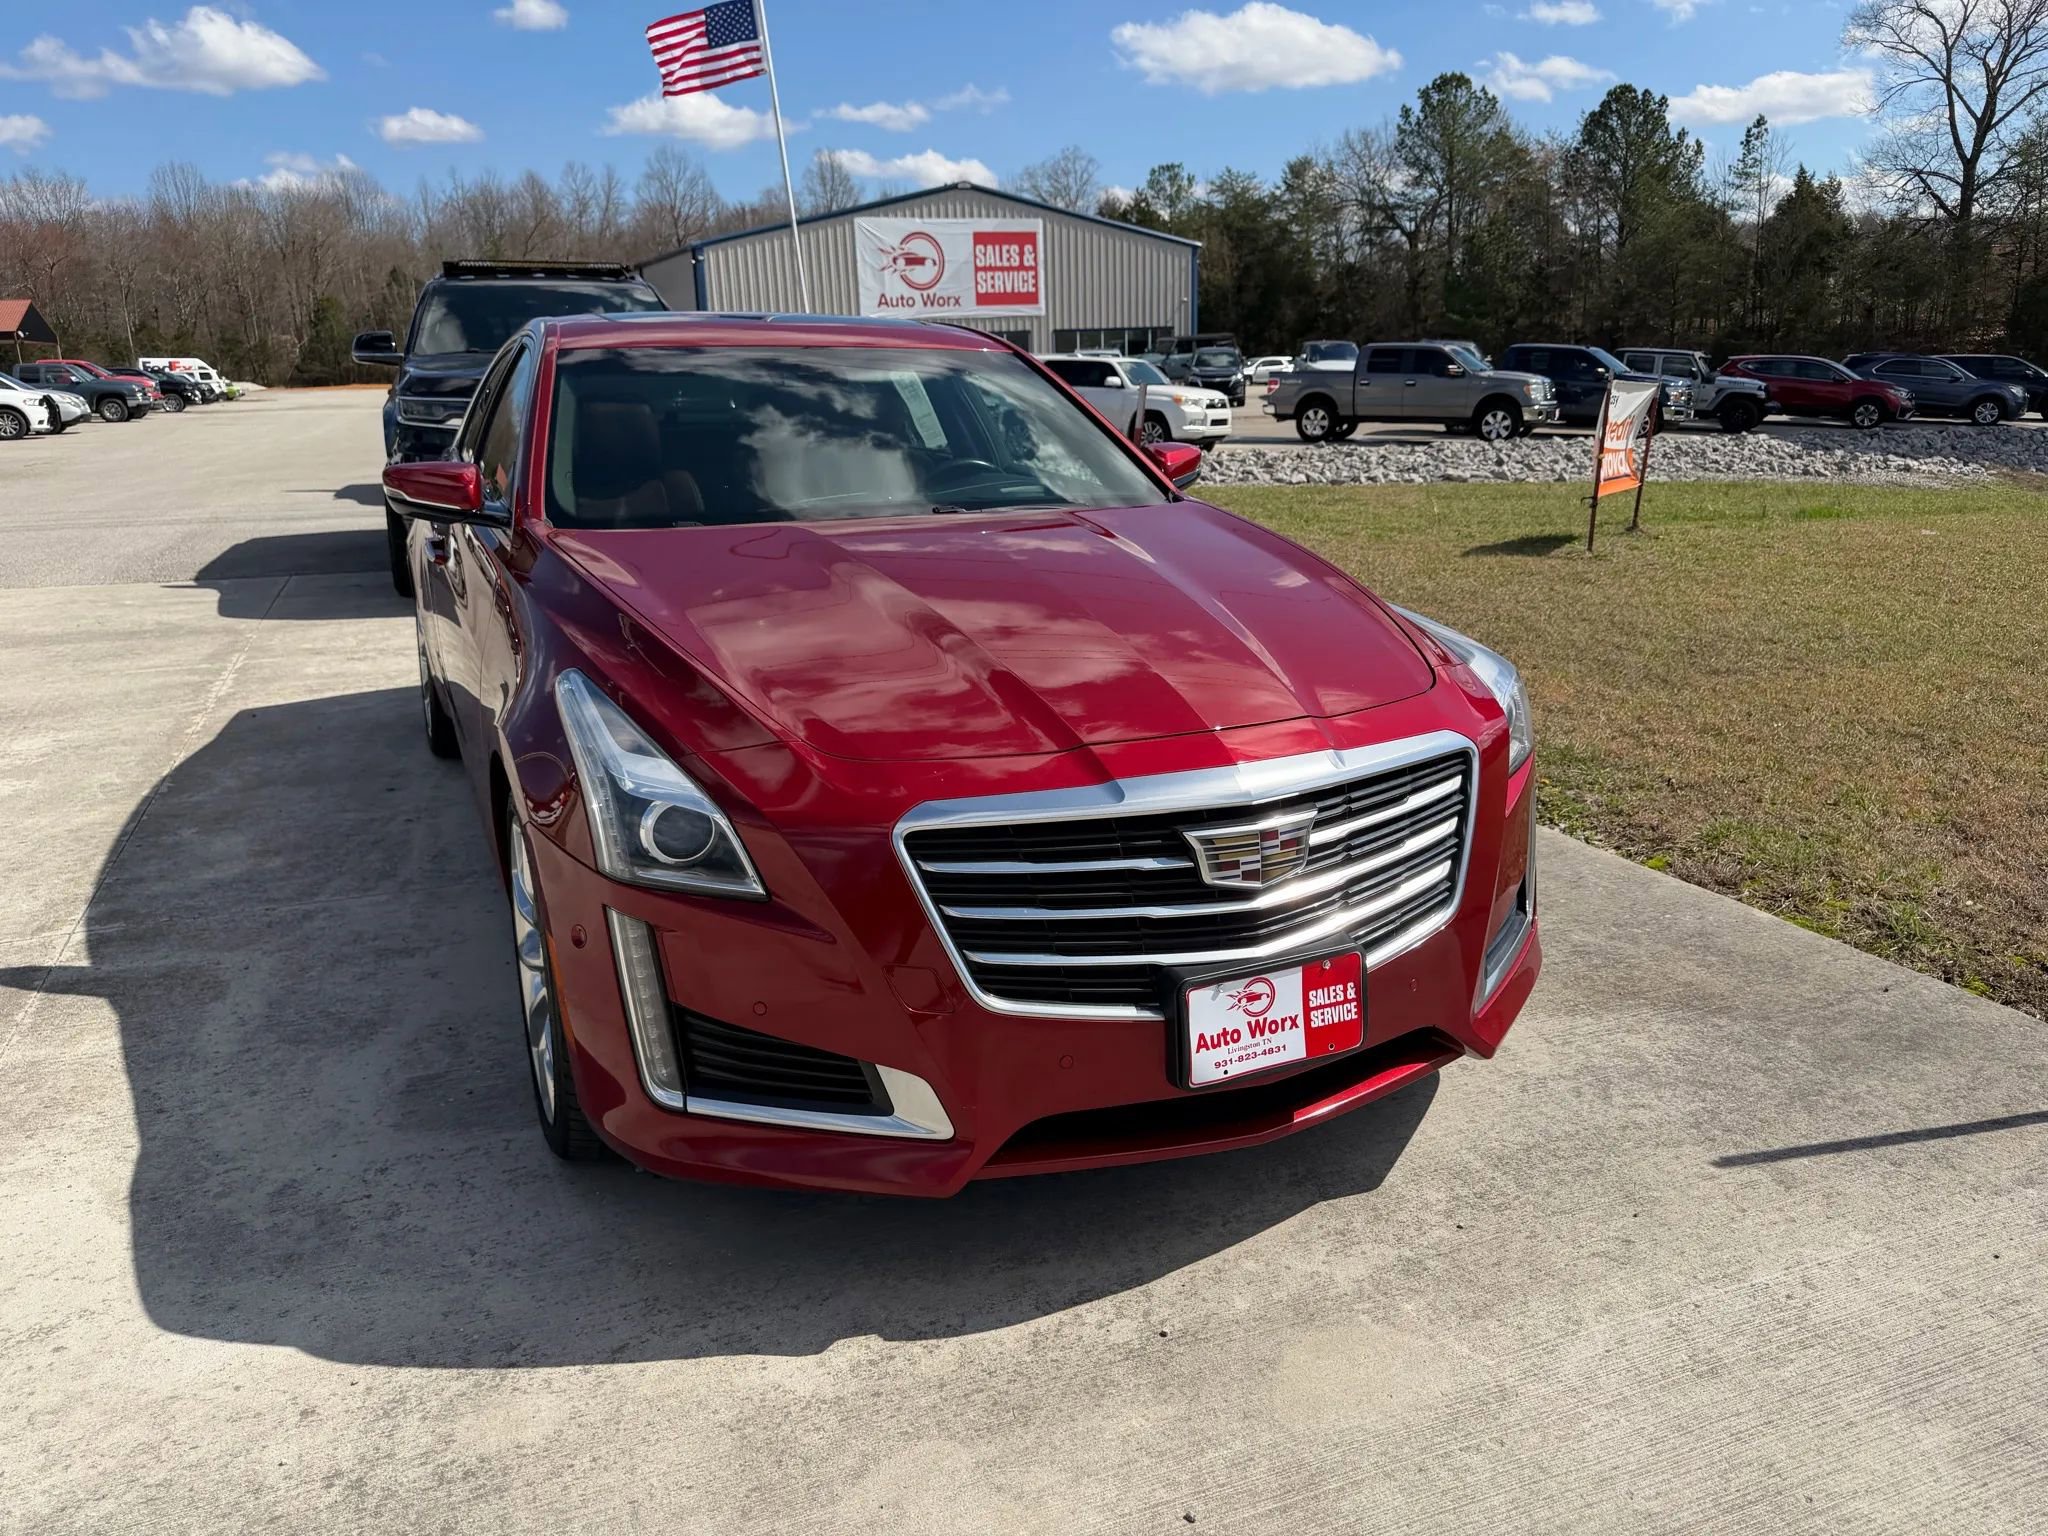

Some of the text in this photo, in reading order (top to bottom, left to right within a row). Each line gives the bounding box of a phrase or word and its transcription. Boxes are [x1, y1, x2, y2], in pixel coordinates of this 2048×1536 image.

[976, 244, 1036, 267] SALES &
[976, 270, 1036, 294] SERVICE
[877, 292, 961, 308] Auto Worx
[1309, 982, 1356, 1008] SALES &
[1310, 1002, 1358, 1028] SERVICE
[1195, 1014, 1300, 1053] Auto Worx
[1214, 1044, 1287, 1069] 931-823-4831
[1227, 1037, 1272, 1055] Livingston TN
